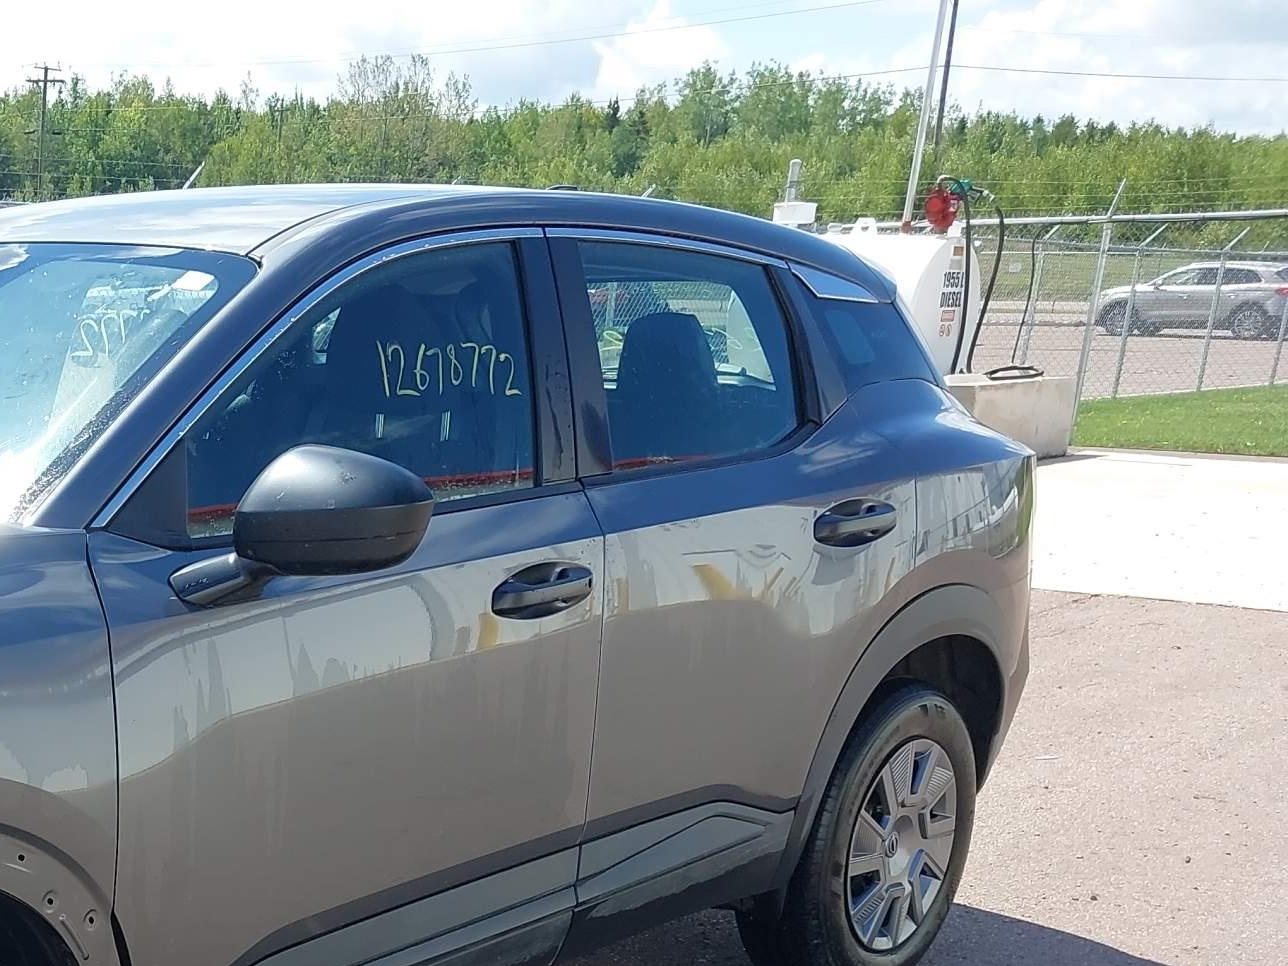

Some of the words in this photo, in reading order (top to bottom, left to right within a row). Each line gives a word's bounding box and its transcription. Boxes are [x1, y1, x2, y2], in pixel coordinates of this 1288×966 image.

[942, 271, 961, 289] 1955
[939, 291, 962, 309] DIESEL
[376, 340, 522, 398] 12678772
